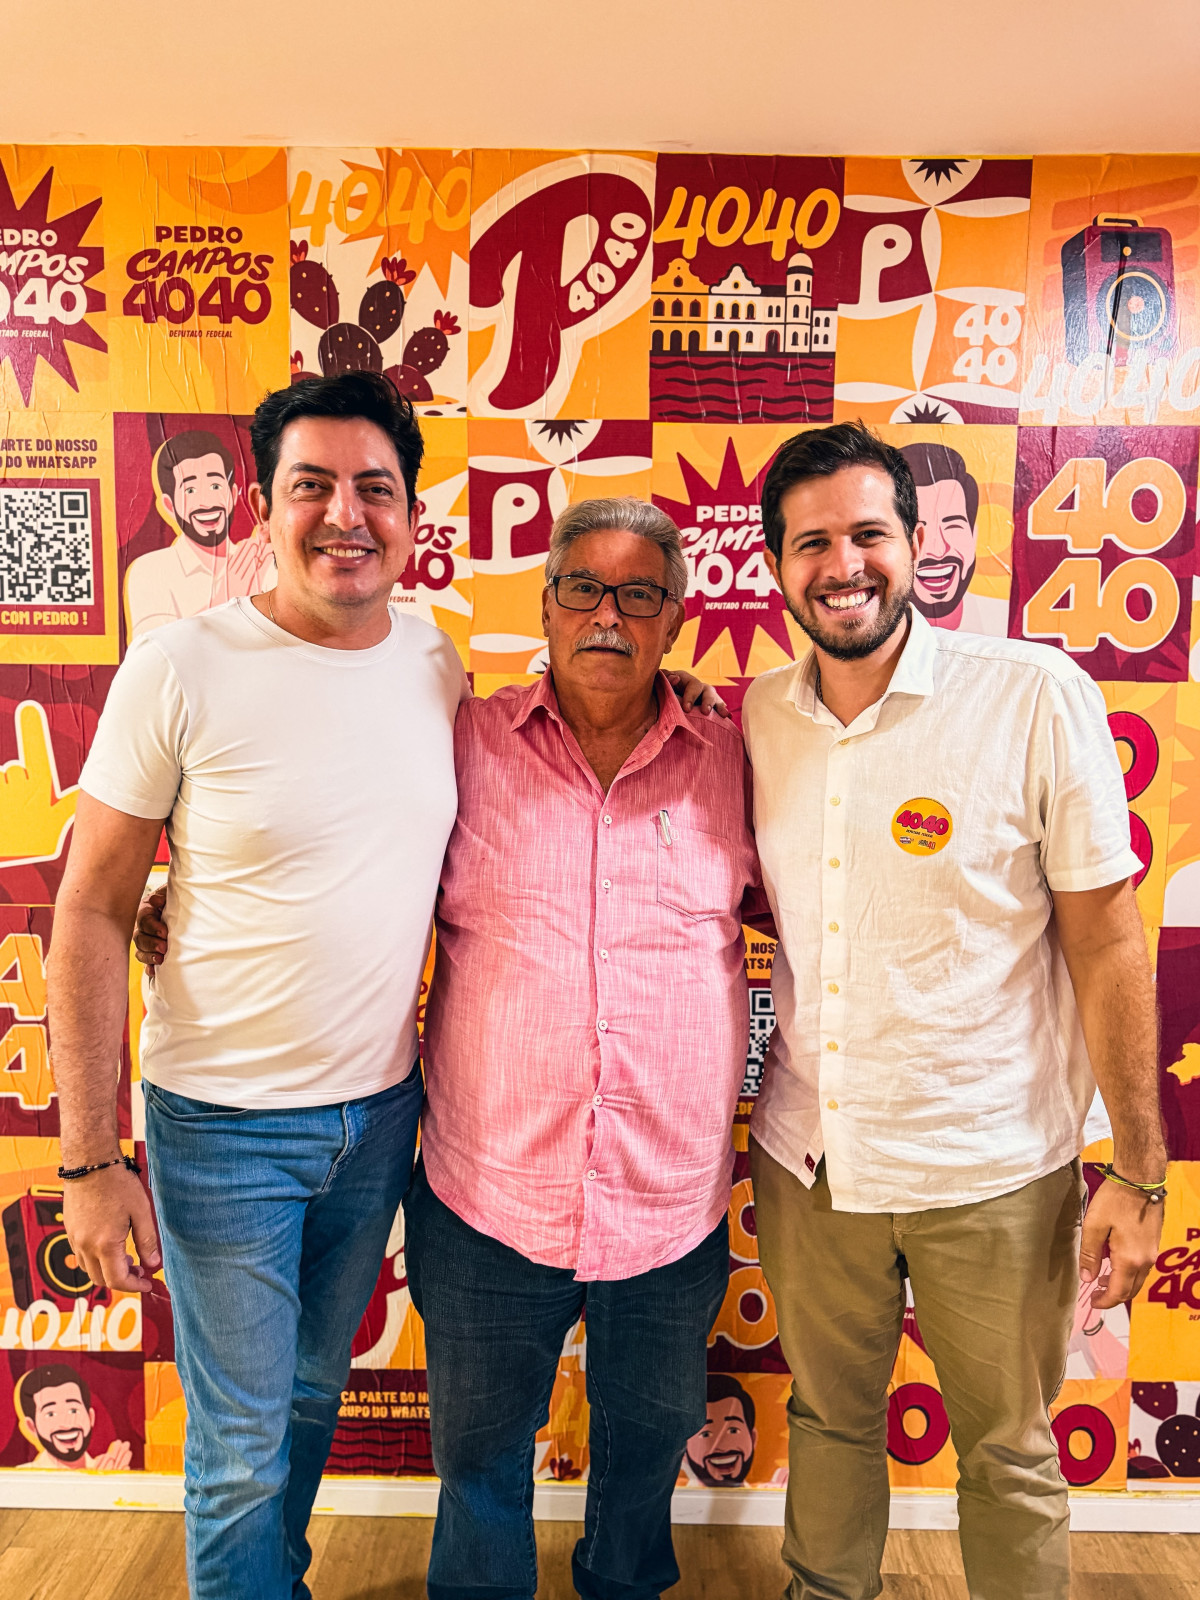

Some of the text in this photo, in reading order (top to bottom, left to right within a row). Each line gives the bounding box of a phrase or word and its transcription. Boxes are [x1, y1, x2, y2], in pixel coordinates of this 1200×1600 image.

[290, 167, 472, 247] 4040
[652, 186, 841, 261] 4040
[0, 228, 58, 247] DRO
[156, 226, 243, 244] PEDRO
[126, 246, 275, 282] CAMPOS
[568, 212, 647, 313] 4040
[0, 277, 88, 325] 40
[122, 276, 272, 325] 4040
[21, 329, 49, 337] FEDERAL
[953, 304, 1022, 346] 40
[953, 346, 1018, 386] 40
[1018, 348, 1200, 425] 4040
[6, 456, 22, 468] DO
[26, 456, 97, 469] WHATSAPP
[35, 438, 53, 452] DO
[55, 438, 98, 452] NOSSO
[696, 505, 763, 523] PEDR
[1027, 457, 1187, 554] 40
[683, 552, 784, 598] 04
[389, 595, 417, 603] FEDERAL
[705, 601, 770, 610] DEPUTADO FEDERAL
[1023, 557, 1180, 653] 40
[1, 610, 31, 625] COM
[33, 611, 79, 626] PEDRO
[896, 809, 950, 836] 4040
[0, 1023, 58, 1110] 4
[337, 1405, 371, 1418] RUPO
[372, 1406, 388, 1418] DO
[359, 1391, 398, 1404] PARTE
[400, 1391, 416, 1404] DO
